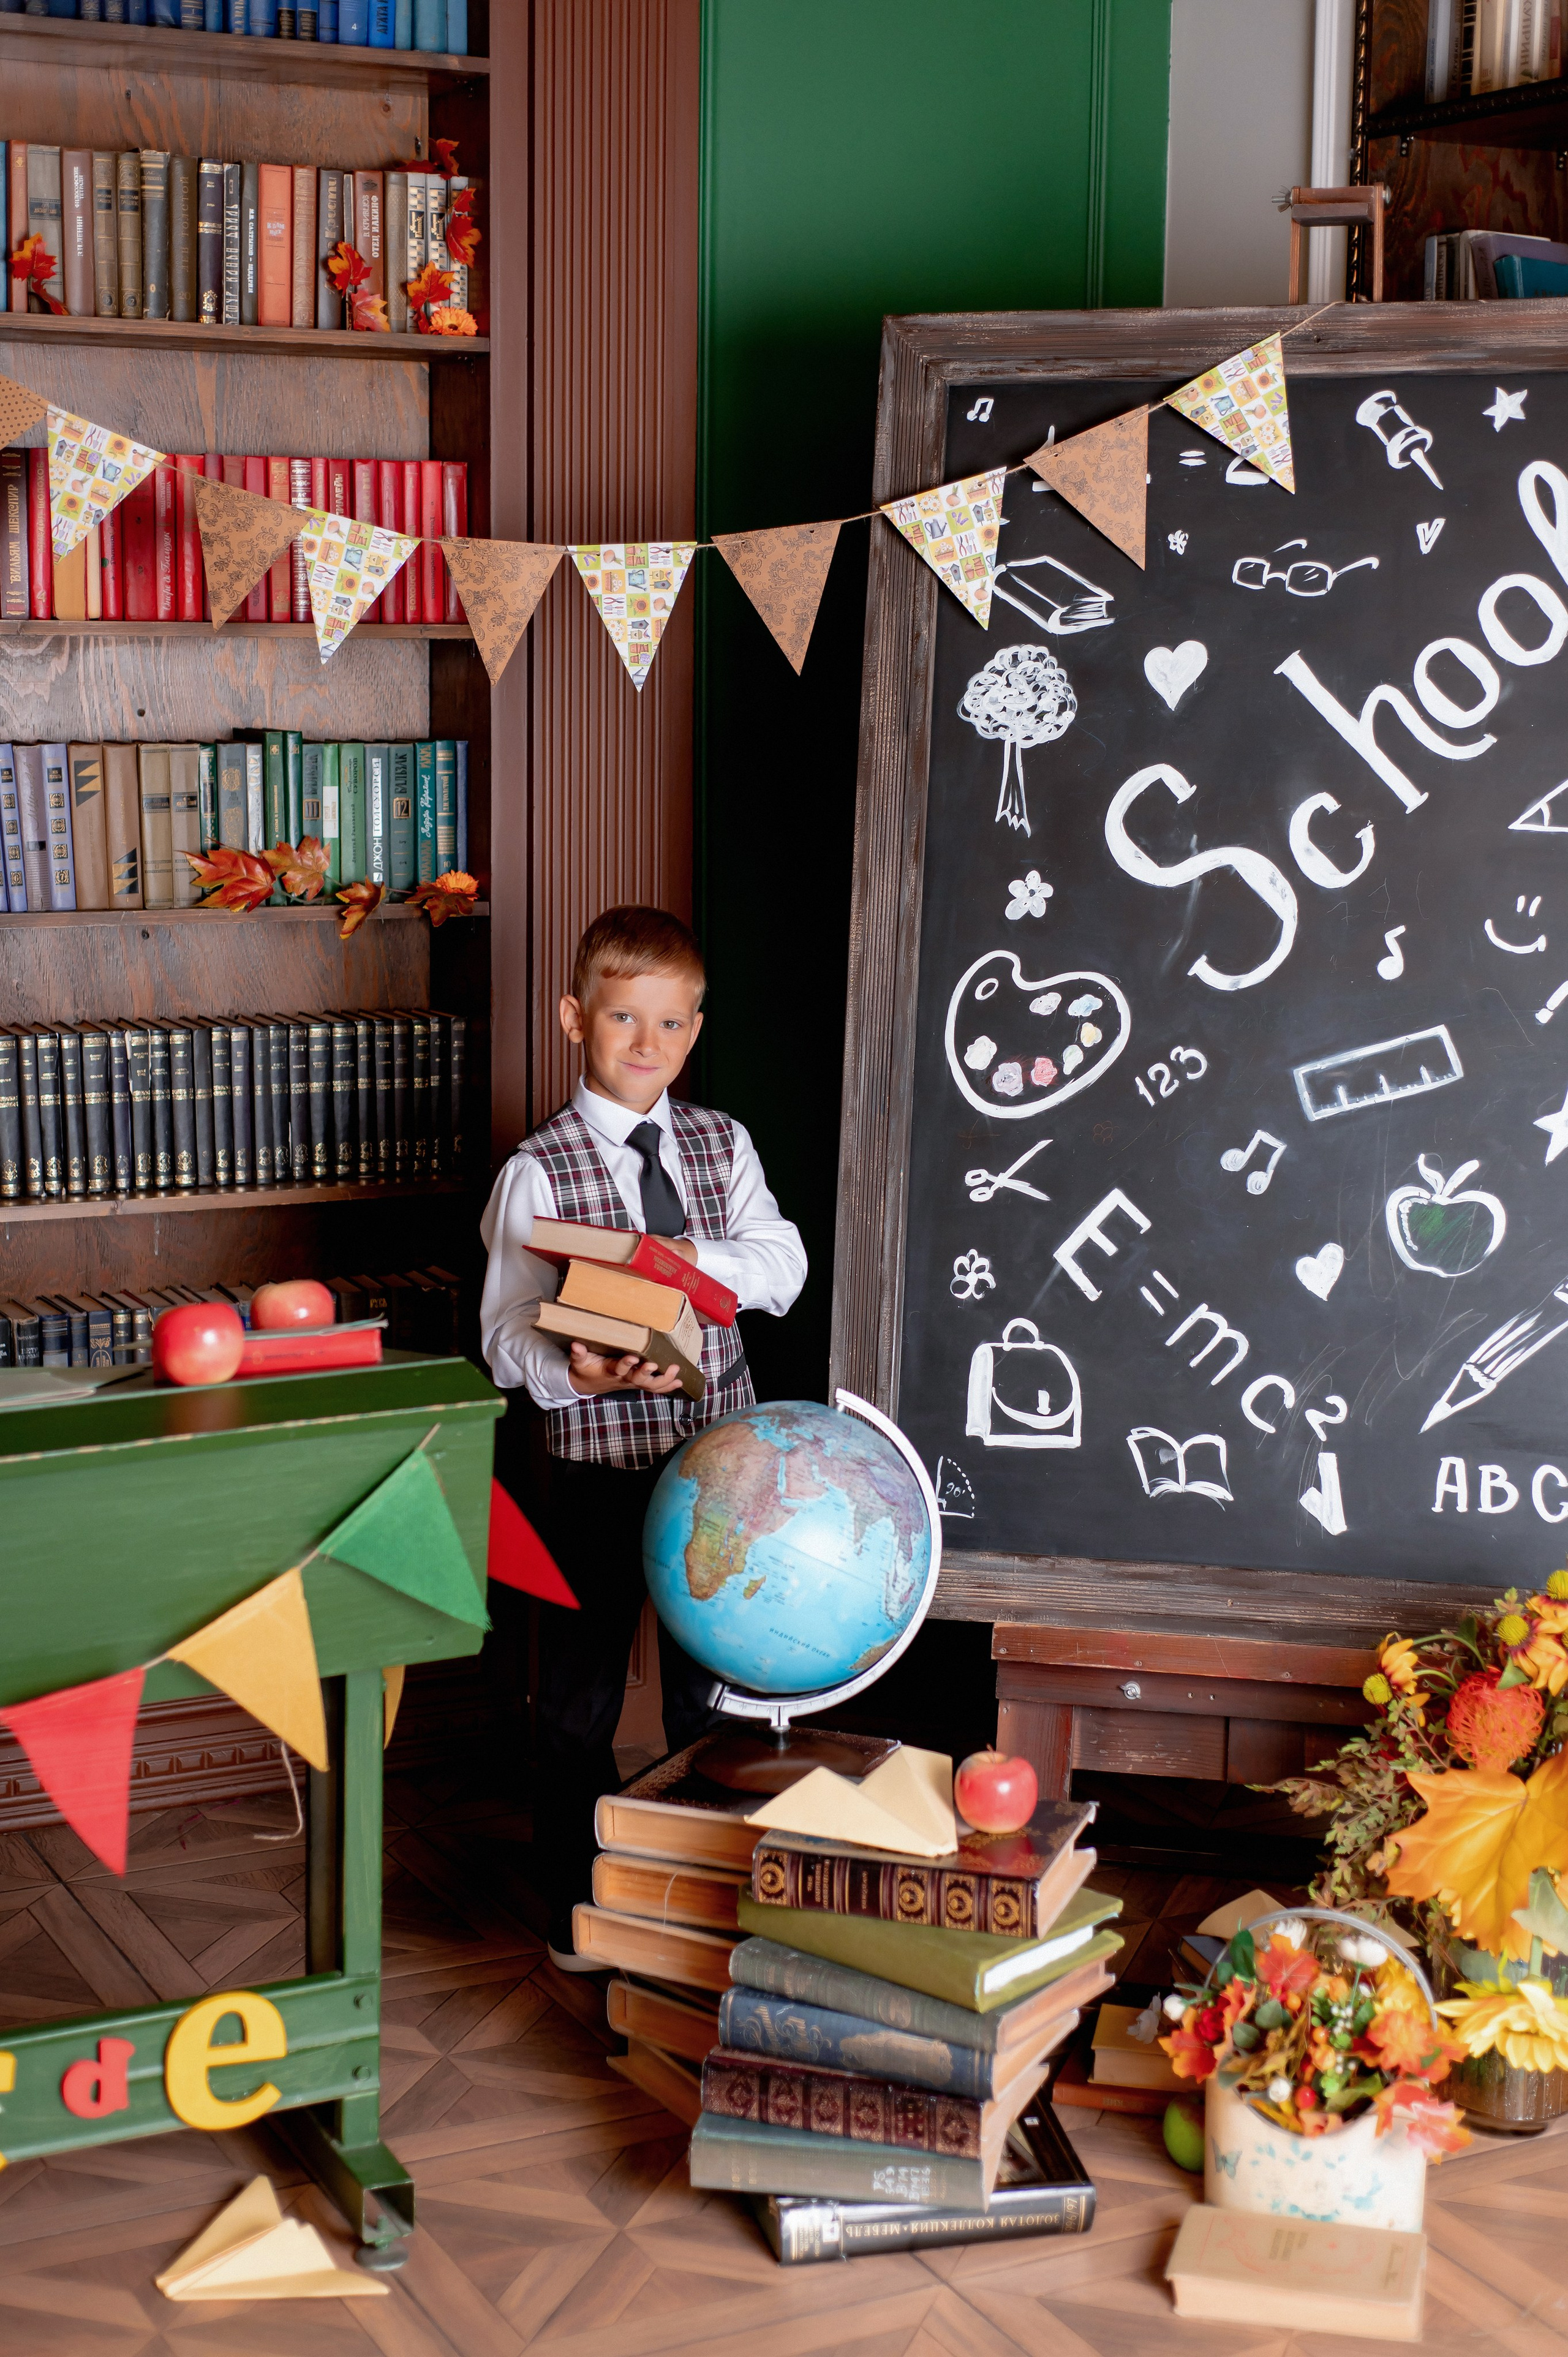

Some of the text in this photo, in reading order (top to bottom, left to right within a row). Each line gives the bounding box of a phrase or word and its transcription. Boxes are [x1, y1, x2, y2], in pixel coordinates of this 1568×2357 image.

[351, 23, 357, 31] 4
[377, 6, 388, 35] АГАТА
[180, 176, 189, 238] ТОЛСТОЙ
[325, 176, 337, 239] Кристи
[371, 194, 380, 258] ОТЕЦ ИАКИНФ
[179, 292, 191, 300] 20
[8, 483, 21, 584] ВИЛЬЯМ ШЕКСПИР
[160, 532, 172, 573] Бальзак
[394, 753, 407, 794] БАЛЬЗАК
[396, 799, 409, 817] 12
[373, 837, 383, 871] ДЖОН
[1136, 1045, 1208, 1106] 123
[769, 1627, 831, 1658] ИНДИЙСКИЙ ОКЕАН
[845, 2214, 1060, 2238] ЗОЛОТАЯ КОЛЛЕКЦИЯ МЕБЕЛЬ
